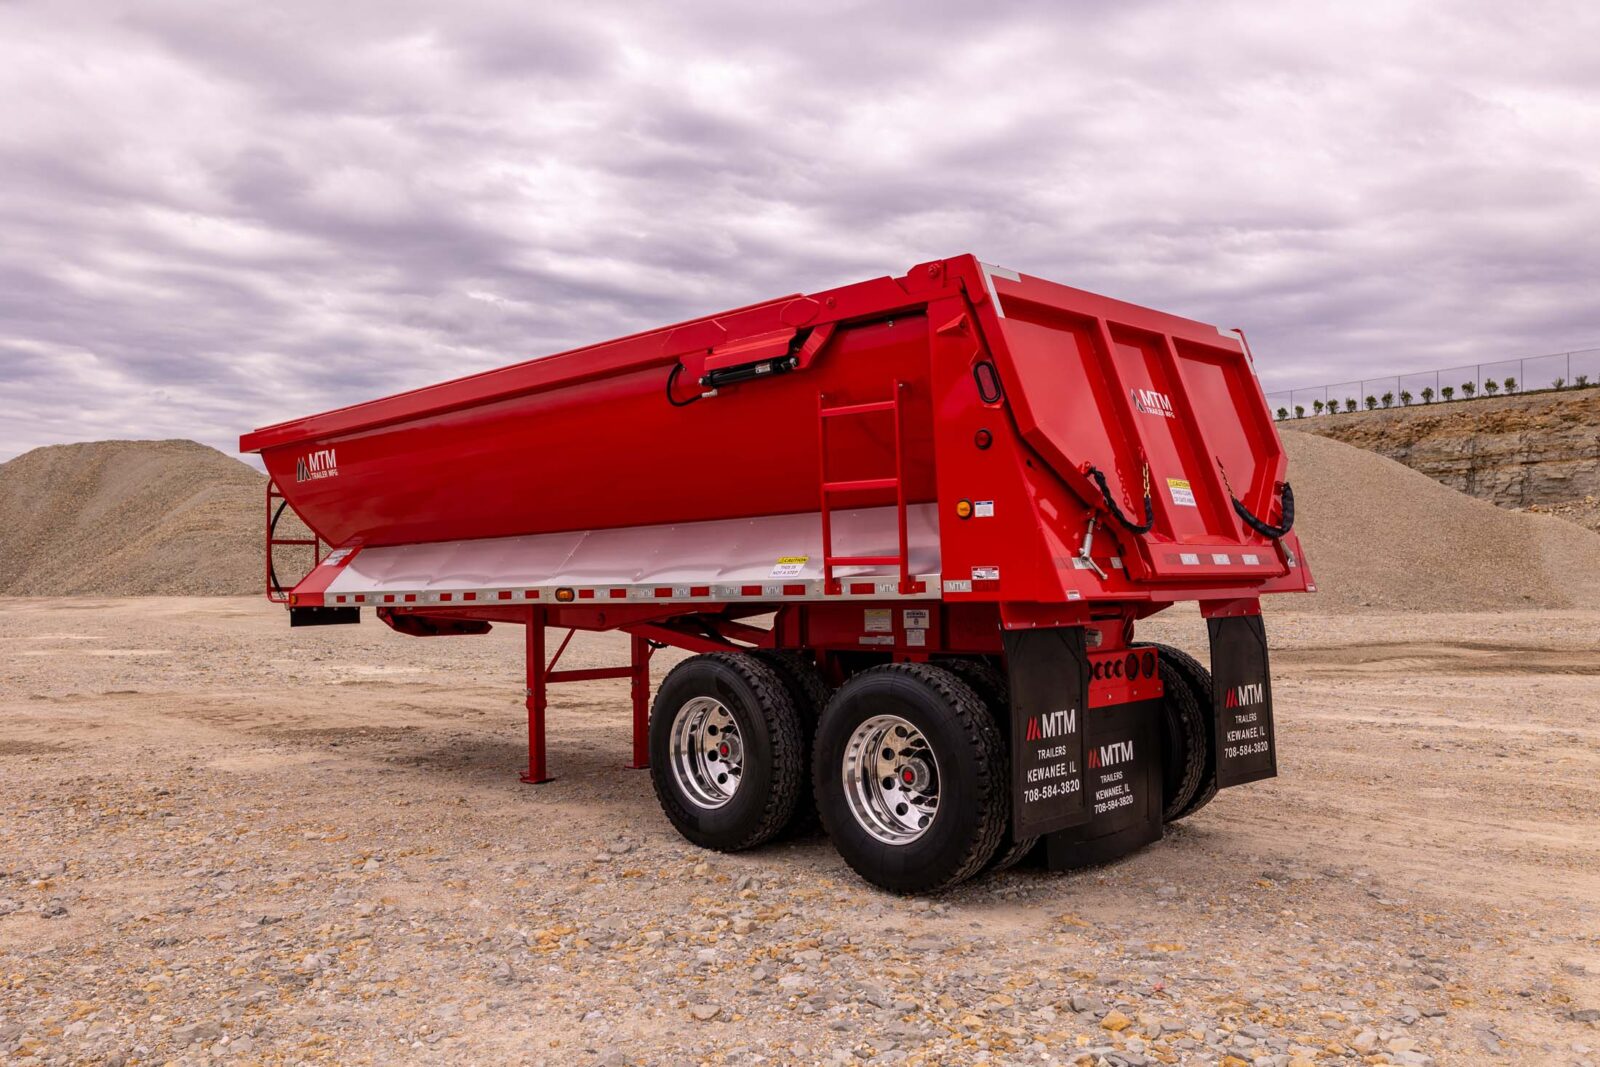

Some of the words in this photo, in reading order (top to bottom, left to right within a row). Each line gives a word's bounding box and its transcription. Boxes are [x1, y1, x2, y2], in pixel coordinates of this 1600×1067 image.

[1139, 388, 1172, 411] MTM
[1145, 407, 1165, 417] TRAILER
[308, 448, 336, 472] MTM
[310, 470, 328, 480] TRAILER
[328, 469, 338, 478] MFG
[1237, 683, 1263, 706] MTM
[1041, 708, 1076, 739] MTM
[1235, 712, 1257, 724] TRAILERS
[1227, 727, 1259, 742] KEWANEE,
[1259, 725, 1265, 736] IL
[1037, 746, 1066, 760] TRAILERS
[1100, 740, 1134, 767] MTM
[1224, 740, 1268, 758] 708-584-3820
[1027, 763, 1068, 783] KEWANEE,
[1069, 761, 1077, 773] IL
[1100, 771, 1123, 784] TRAILERS
[1024, 779, 1080, 804] 708-584-3820
[1095, 785, 1124, 801] KEWANEE,
[1125, 784, 1131, 793] IL
[1094, 795, 1134, 814] 708-584-3820
